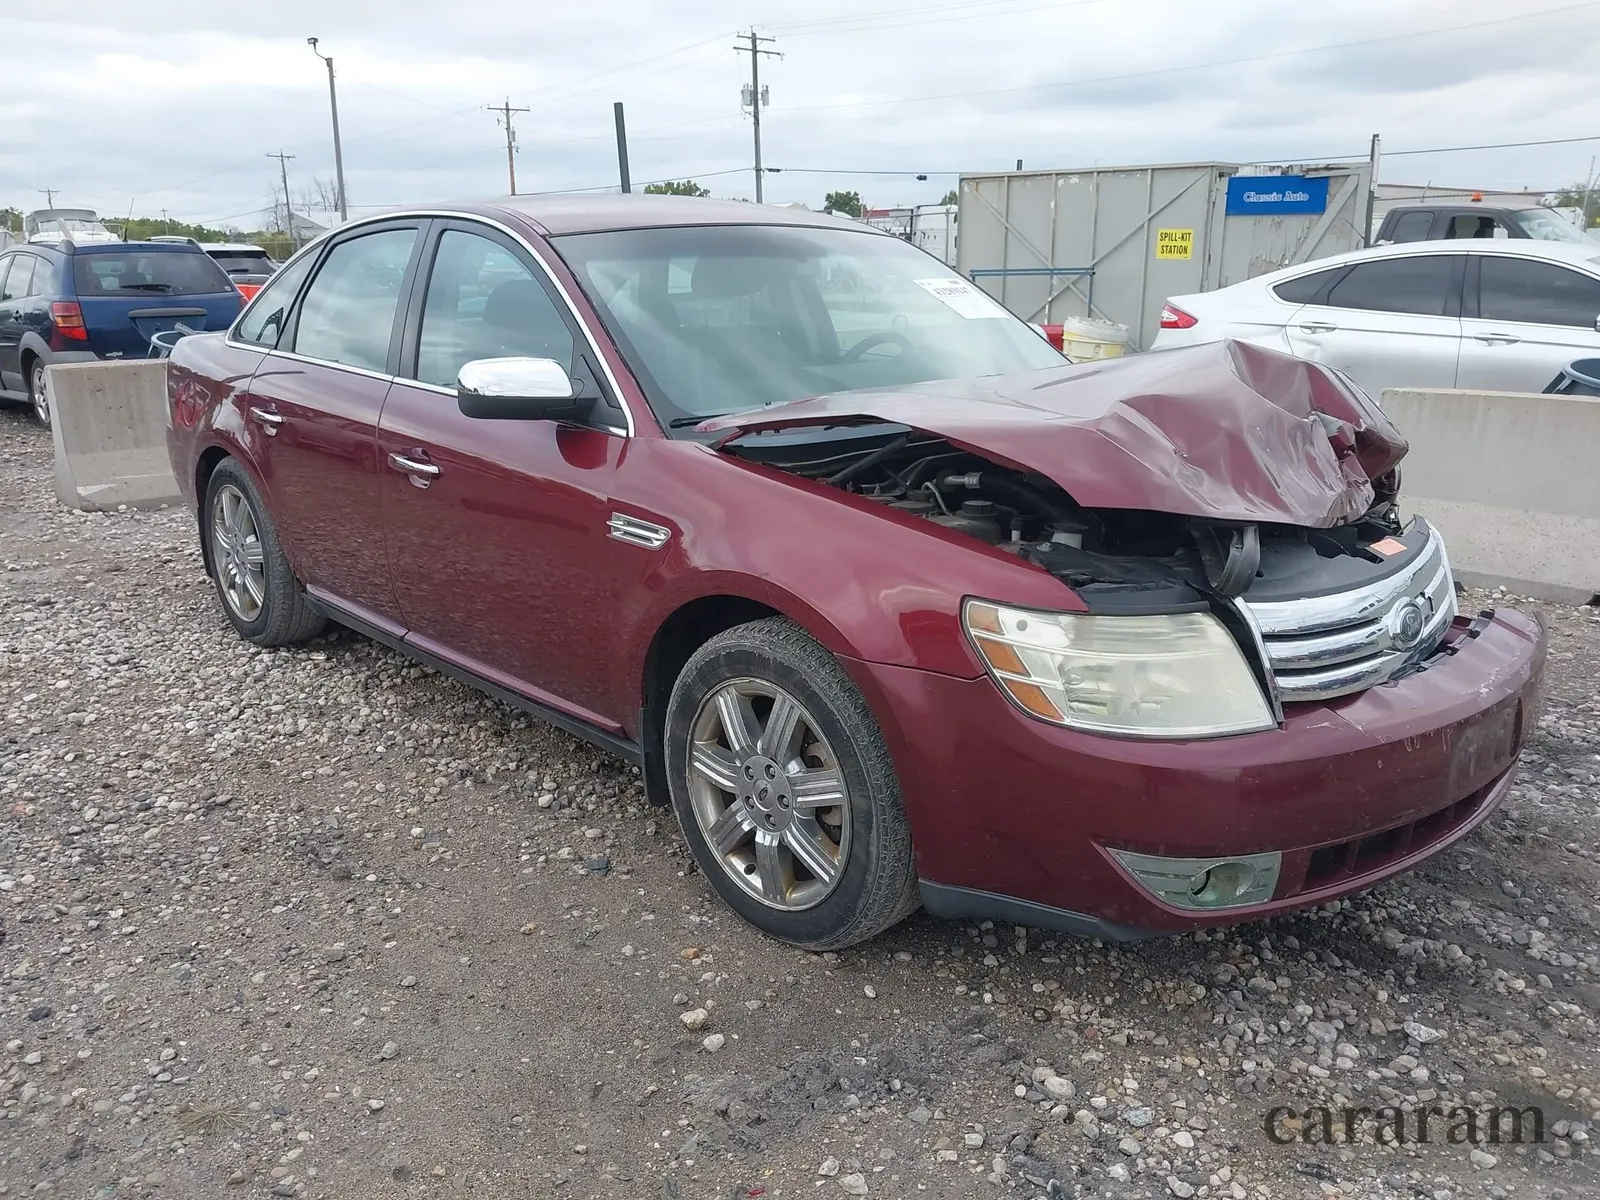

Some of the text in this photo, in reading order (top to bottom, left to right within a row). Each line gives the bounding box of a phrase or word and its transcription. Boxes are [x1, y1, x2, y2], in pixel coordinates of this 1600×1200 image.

[1243, 191, 1309, 202] Classic Auto
[1159, 232, 1191, 242] SPILL-KIT
[1160, 245, 1188, 255] STATION
